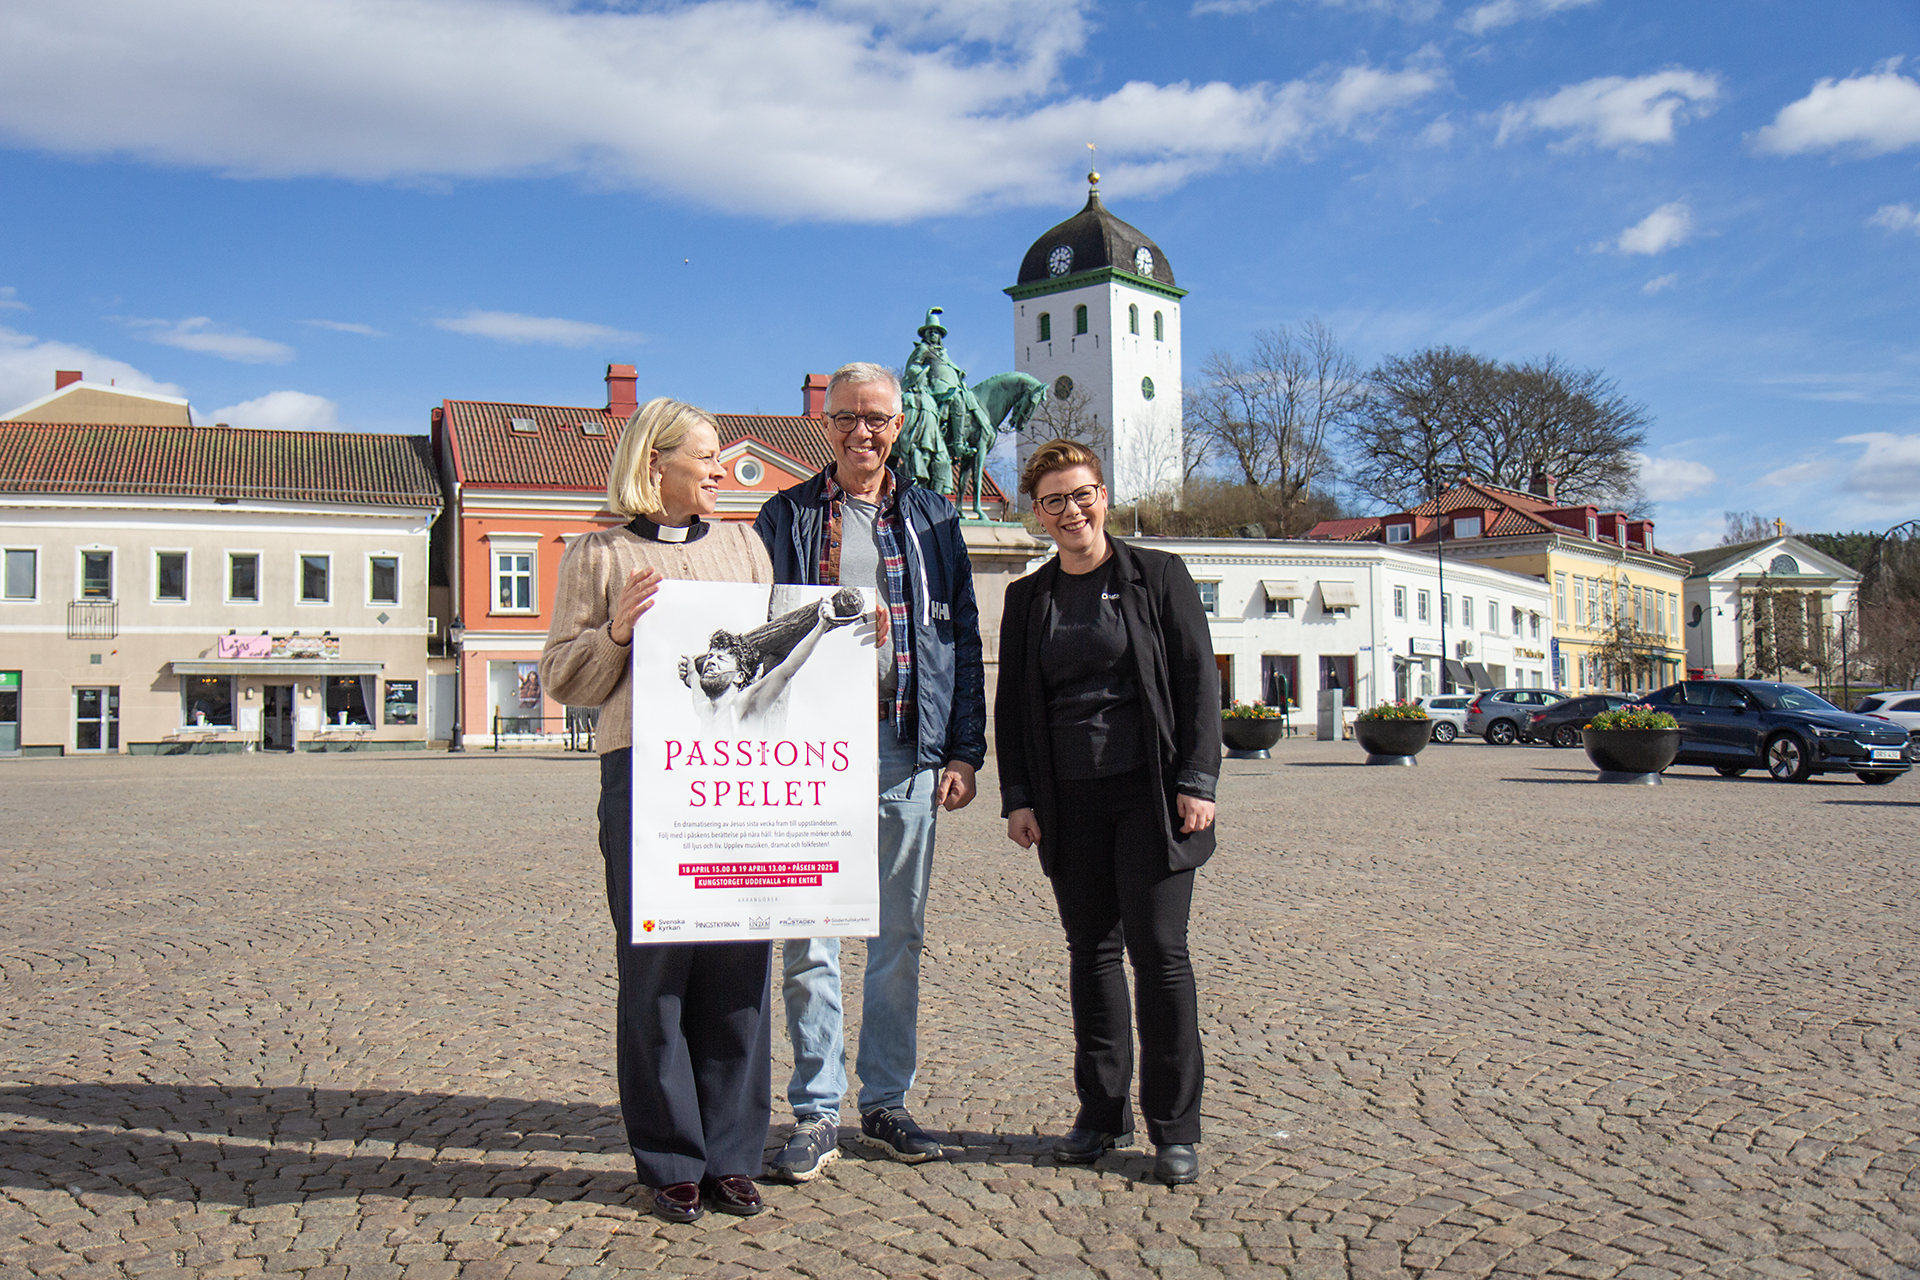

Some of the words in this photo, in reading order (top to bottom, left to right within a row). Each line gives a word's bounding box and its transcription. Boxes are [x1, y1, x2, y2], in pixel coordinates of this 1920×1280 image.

[664, 740, 849, 771] PASSIONS
[689, 780, 826, 807] SPELET
[682, 820, 721, 829] dramatisering
[798, 819, 838, 828] uppståndelsen.
[658, 832, 668, 840] Följ
[687, 831, 710, 839] påskens
[740, 831, 746, 839] på
[786, 830, 809, 838] djupaste
[841, 829, 852, 837] död,
[692, 842, 702, 850] ljus
[723, 842, 743, 850] Upplev
[745, 841, 770, 849] musiken,
[801, 840, 829, 848] folkfesten!
[691, 865, 710, 873] APRIL
[712, 865, 730, 873] 15.00
[732, 865, 737, 873] &
[748, 864, 767, 872] APRIL
[768, 864, 787, 872] 13.00
[792, 862, 816, 871] PÅSKEN
[698, 877, 743, 886] KUNGSTORGET
[745, 877, 781, 885] UDDEVALLA
[798, 875, 817, 884] ENTRÉ
